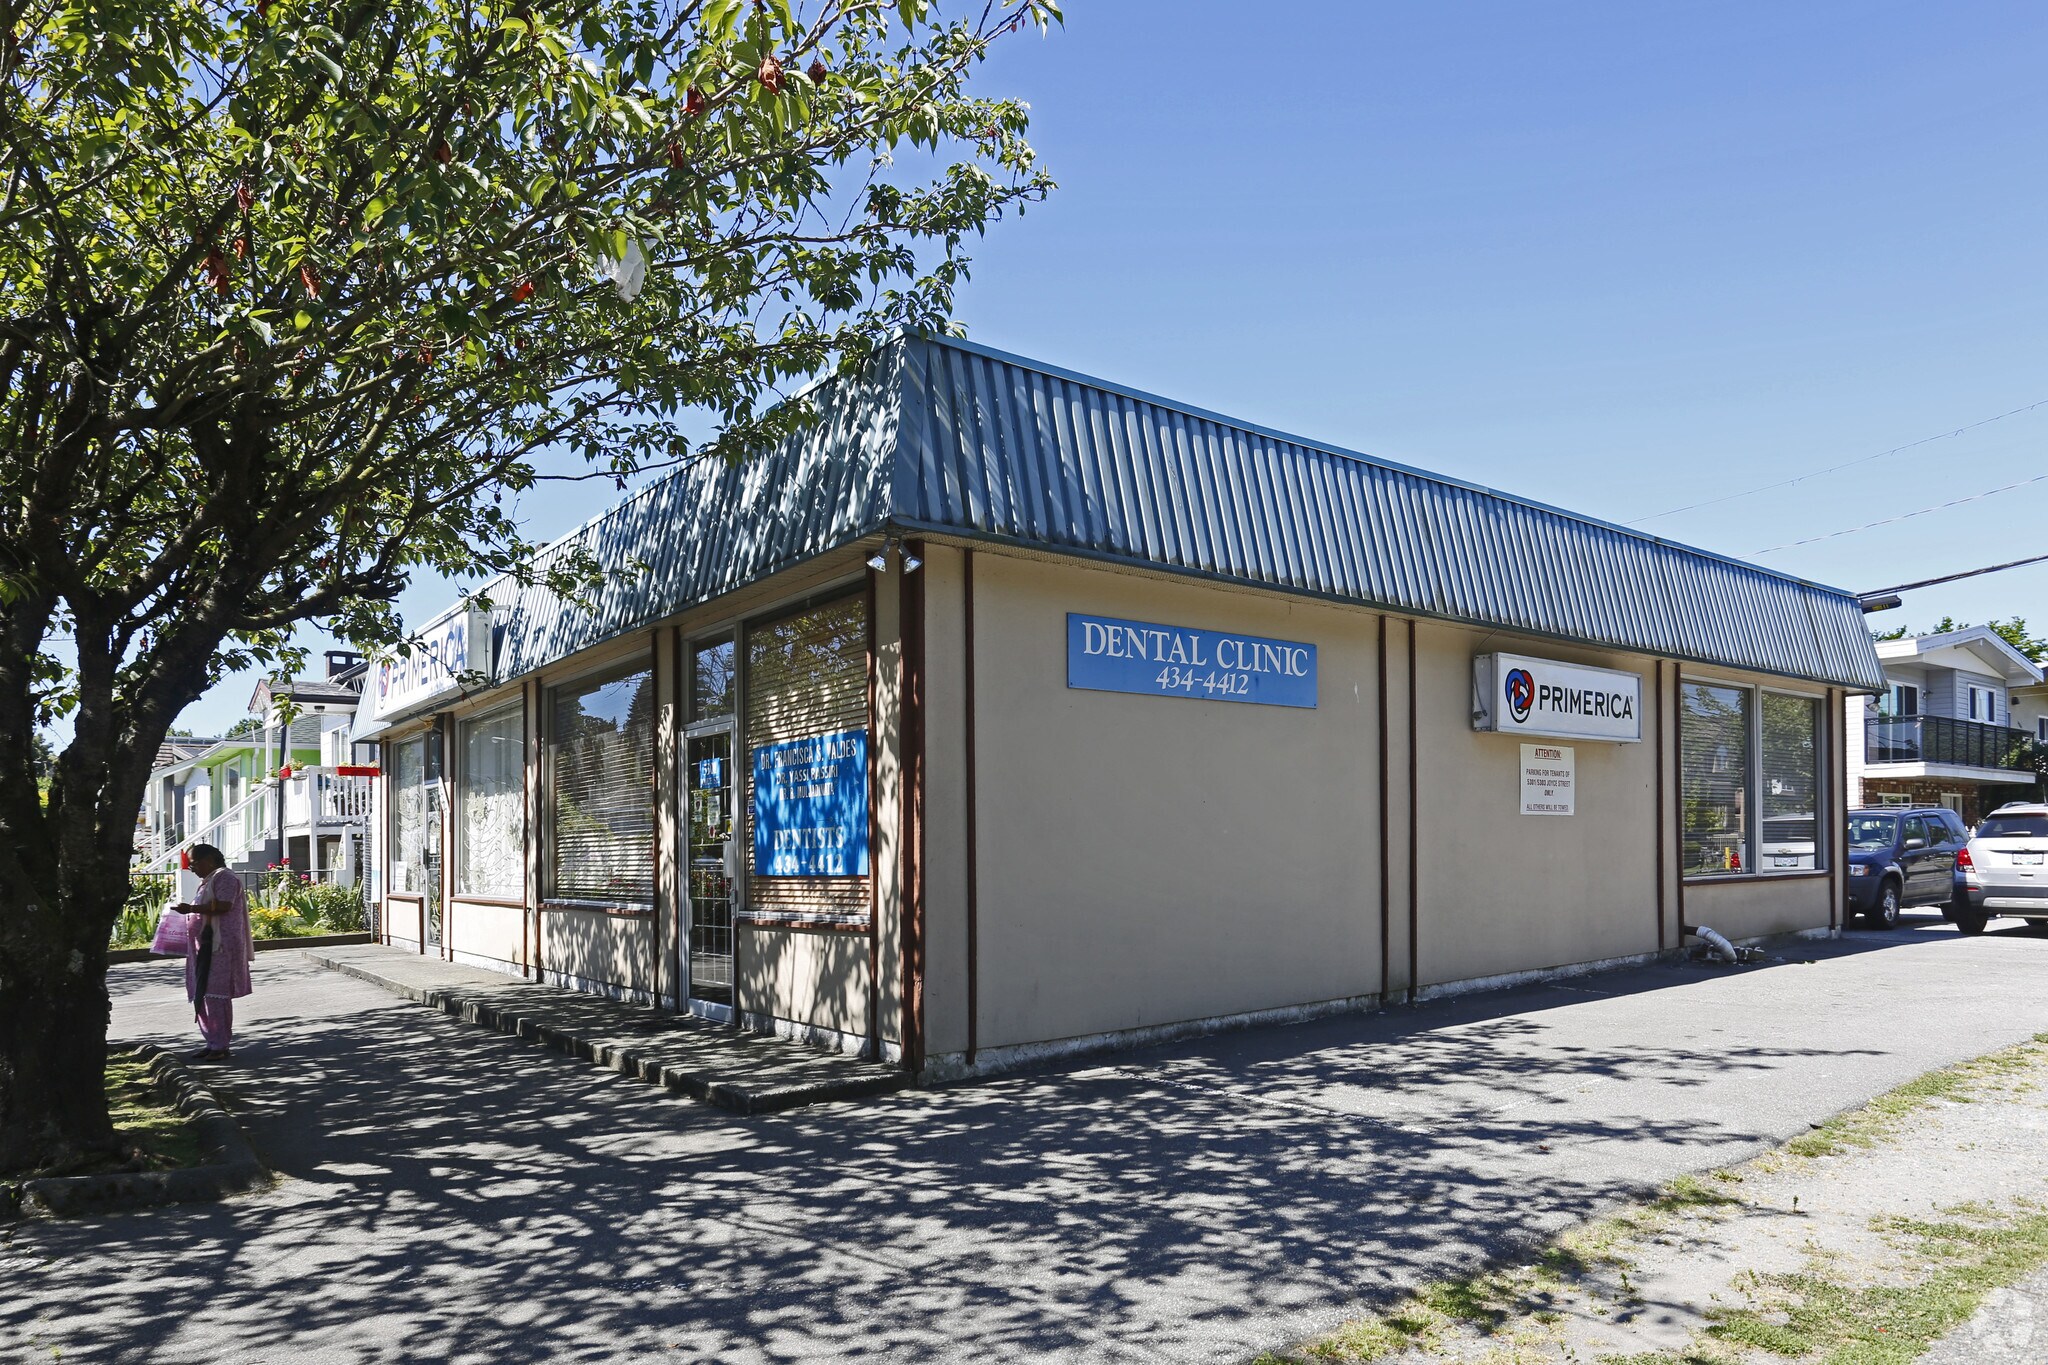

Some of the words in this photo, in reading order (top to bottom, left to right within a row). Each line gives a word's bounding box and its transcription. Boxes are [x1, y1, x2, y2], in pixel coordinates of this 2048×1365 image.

[391, 623, 467, 699] PRIMERICA
[1082, 622, 1207, 666] DENTAL
[1216, 638, 1308, 677] CLINIC
[1156, 666, 1249, 695] 434-4412
[760, 753, 772, 770] DR.
[774, 745, 814, 768] FRANCISCA
[815, 744, 824, 762] S.
[826, 738, 857, 759] VALDES
[776, 771, 788, 785] DR.
[1526, 768, 1541, 776] PARKING
[773, 826, 844, 850] DENTISTS
[774, 853, 844, 874] 434-4412
